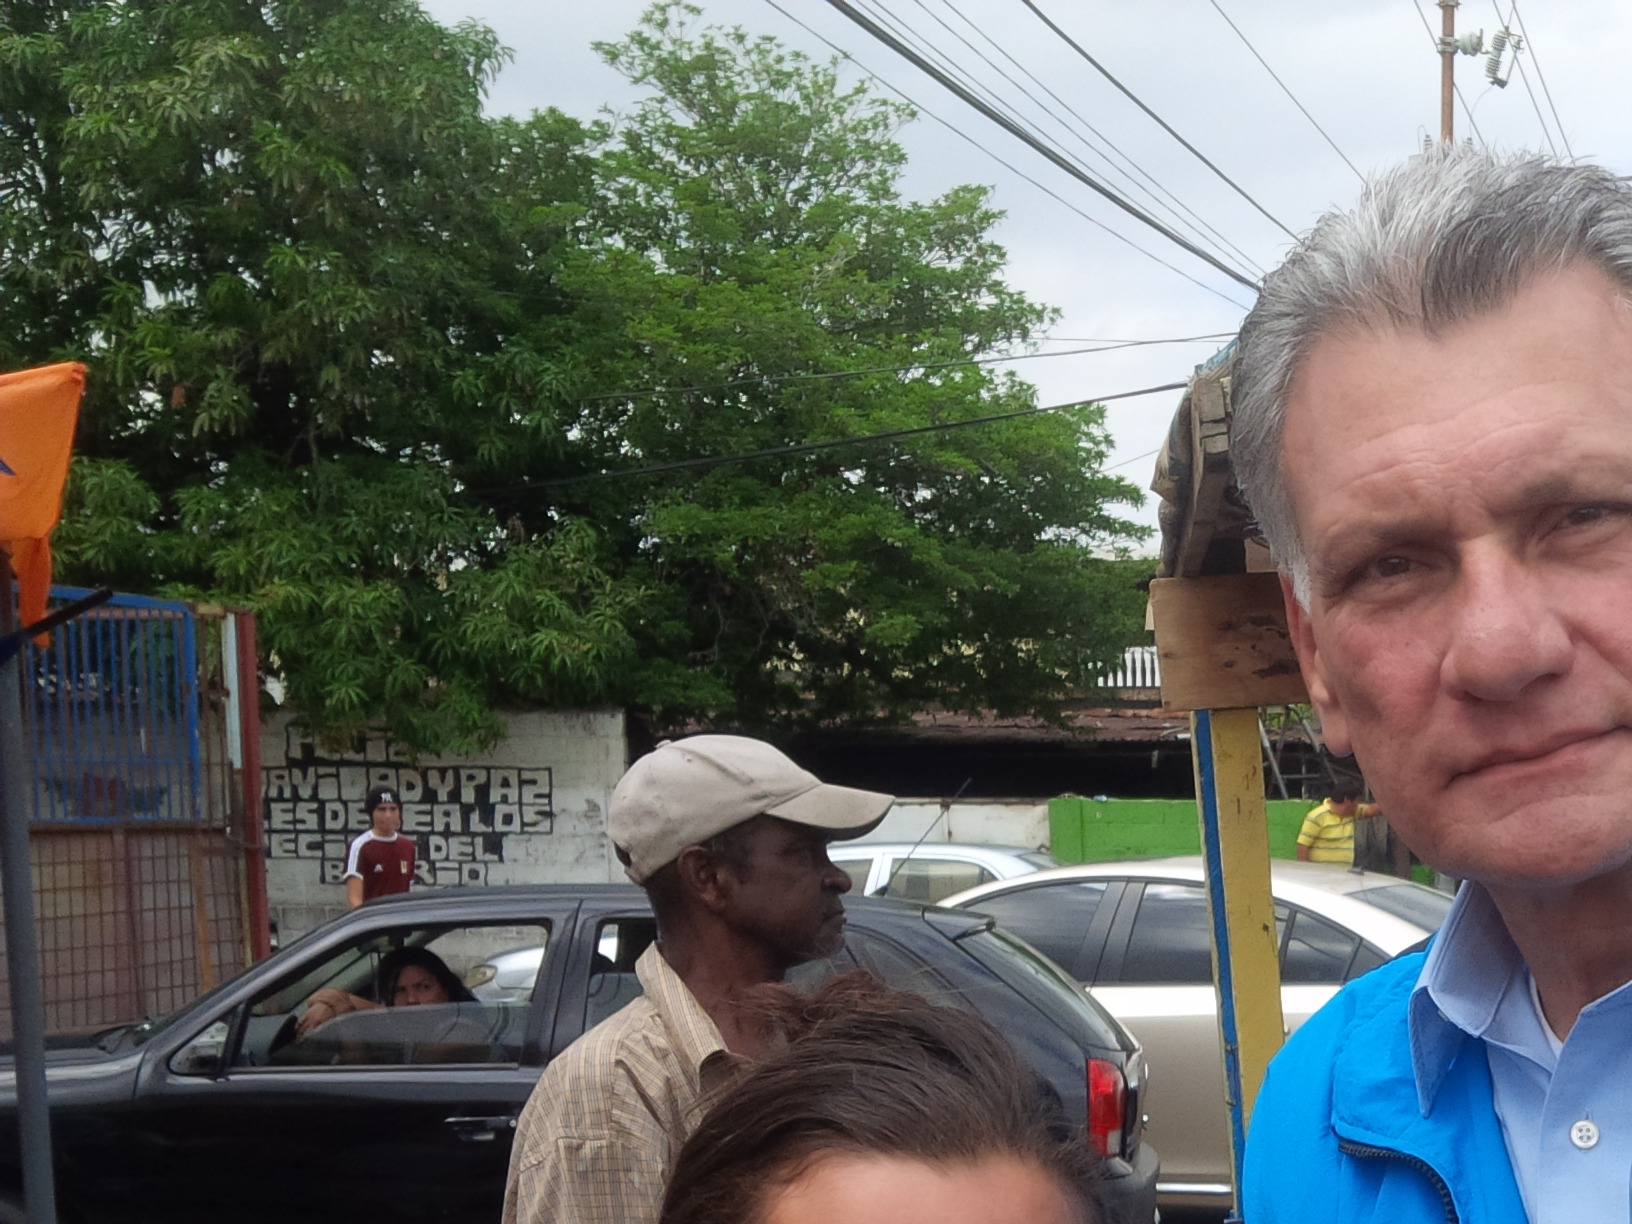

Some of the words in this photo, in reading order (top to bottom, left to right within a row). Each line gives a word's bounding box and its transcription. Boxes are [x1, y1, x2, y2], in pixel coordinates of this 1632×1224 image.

[458, 768, 552, 804] PAZ
[264, 802, 321, 832] ES
[324, 802, 462, 833] DEEA
[468, 802, 553, 834] LOS
[428, 834, 501, 861] DEL
